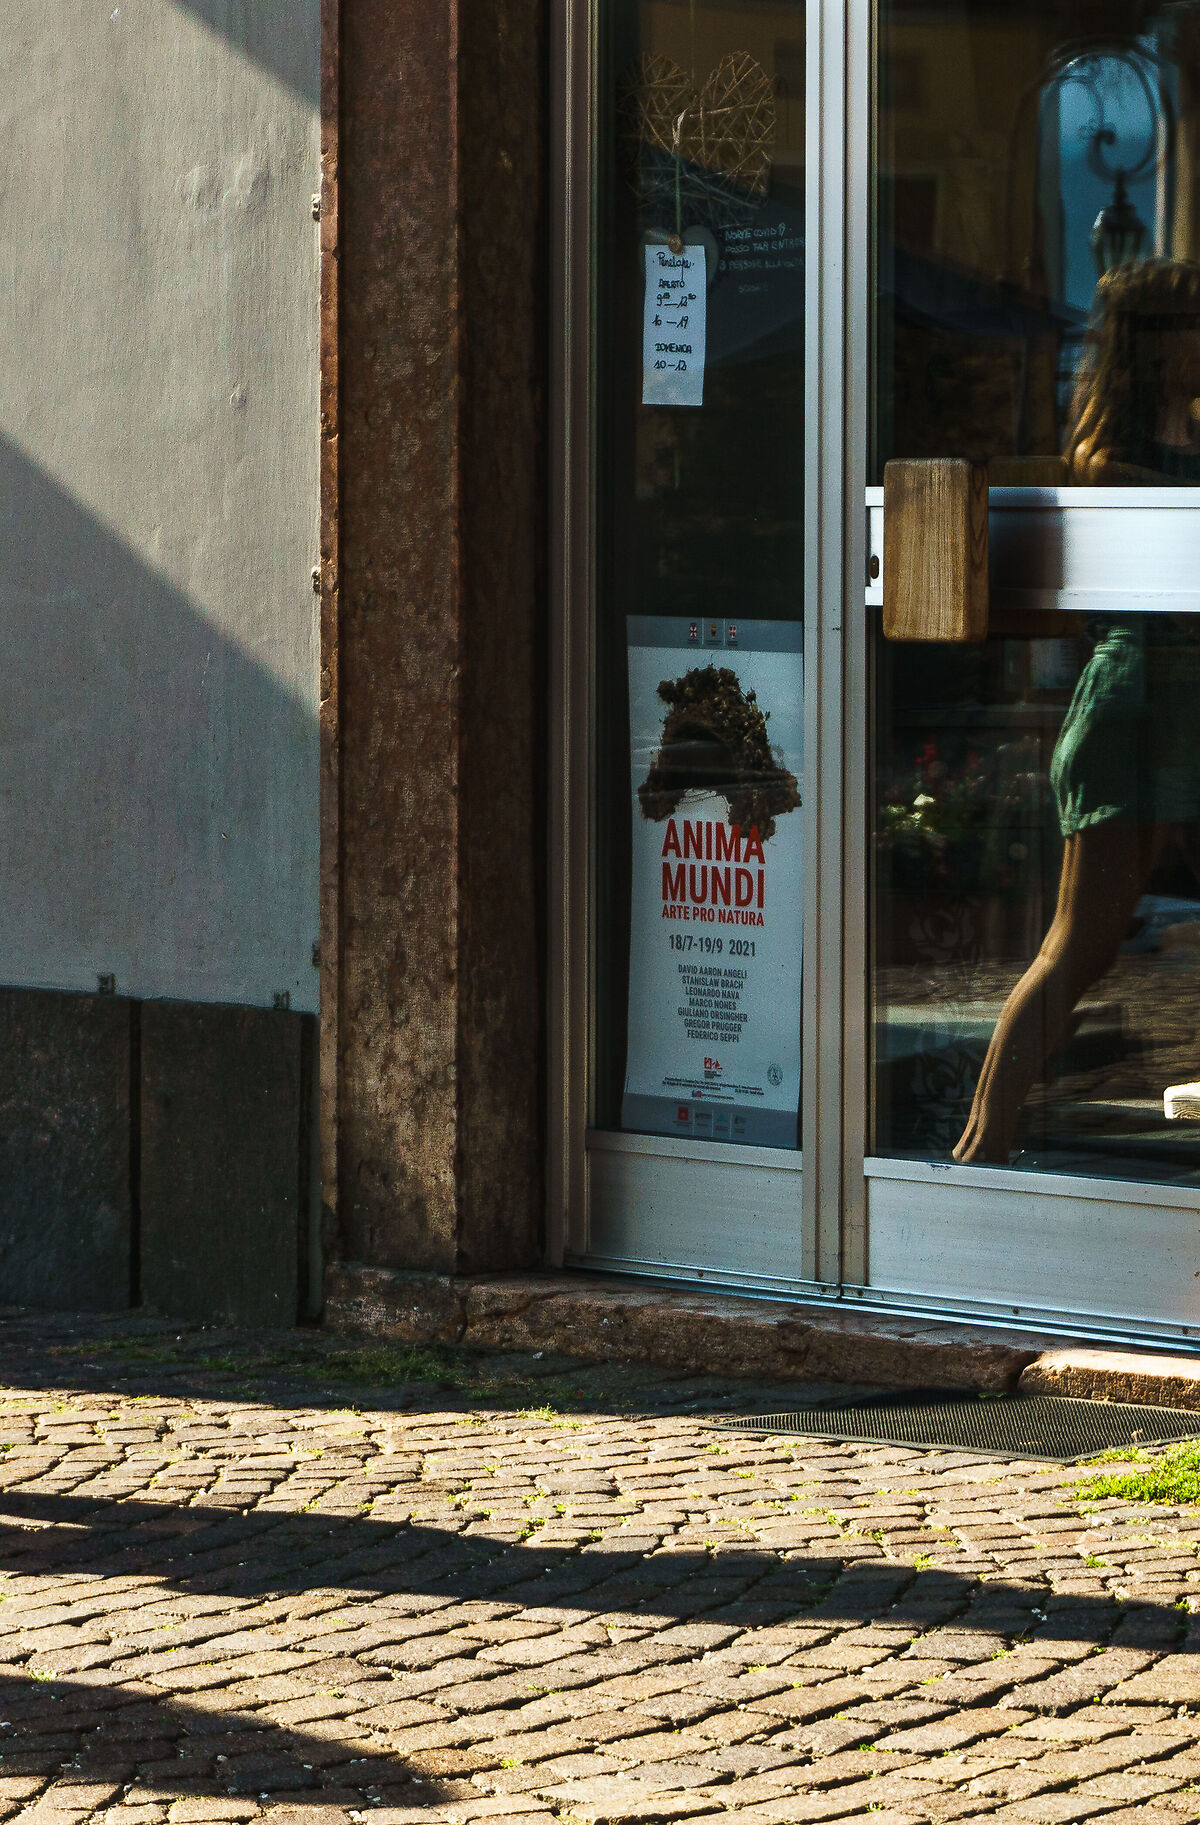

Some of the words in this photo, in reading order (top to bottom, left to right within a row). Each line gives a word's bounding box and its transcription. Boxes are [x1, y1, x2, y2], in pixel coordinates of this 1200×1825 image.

[661, 818, 766, 865] ANIMA
[661, 861, 765, 909] MUNDI
[662, 904, 690, 921] ARTE
[692, 907, 715, 923] PRO
[718, 908, 765, 927] NATURA
[669, 934, 723, 954] 18/7-19/9
[729, 938, 756, 957] 2021
[678, 964, 698, 974] DAVID
[699, 966, 721, 976] AARON
[723, 968, 748, 979] ANGELI
[682, 975, 719, 987] STANISLAW
[720, 979, 744, 989] BRACH
[685, 986, 720, 998] LEONARDO
[721, 990, 740, 1000] NAVA
[689, 998, 713, 1008] MARCO
[714, 1000, 737, 1011] NONES
[678, 1007, 709, 1018] GIULIANO
[710, 1010, 748, 1022] ORSINGHER
[684, 1018, 710, 1029] GREGOR
[711, 1020, 742, 1032] PRUGGER
[687, 1030, 719, 1041] FEDERICO
[719, 1032, 739, 1043] SEPPI
